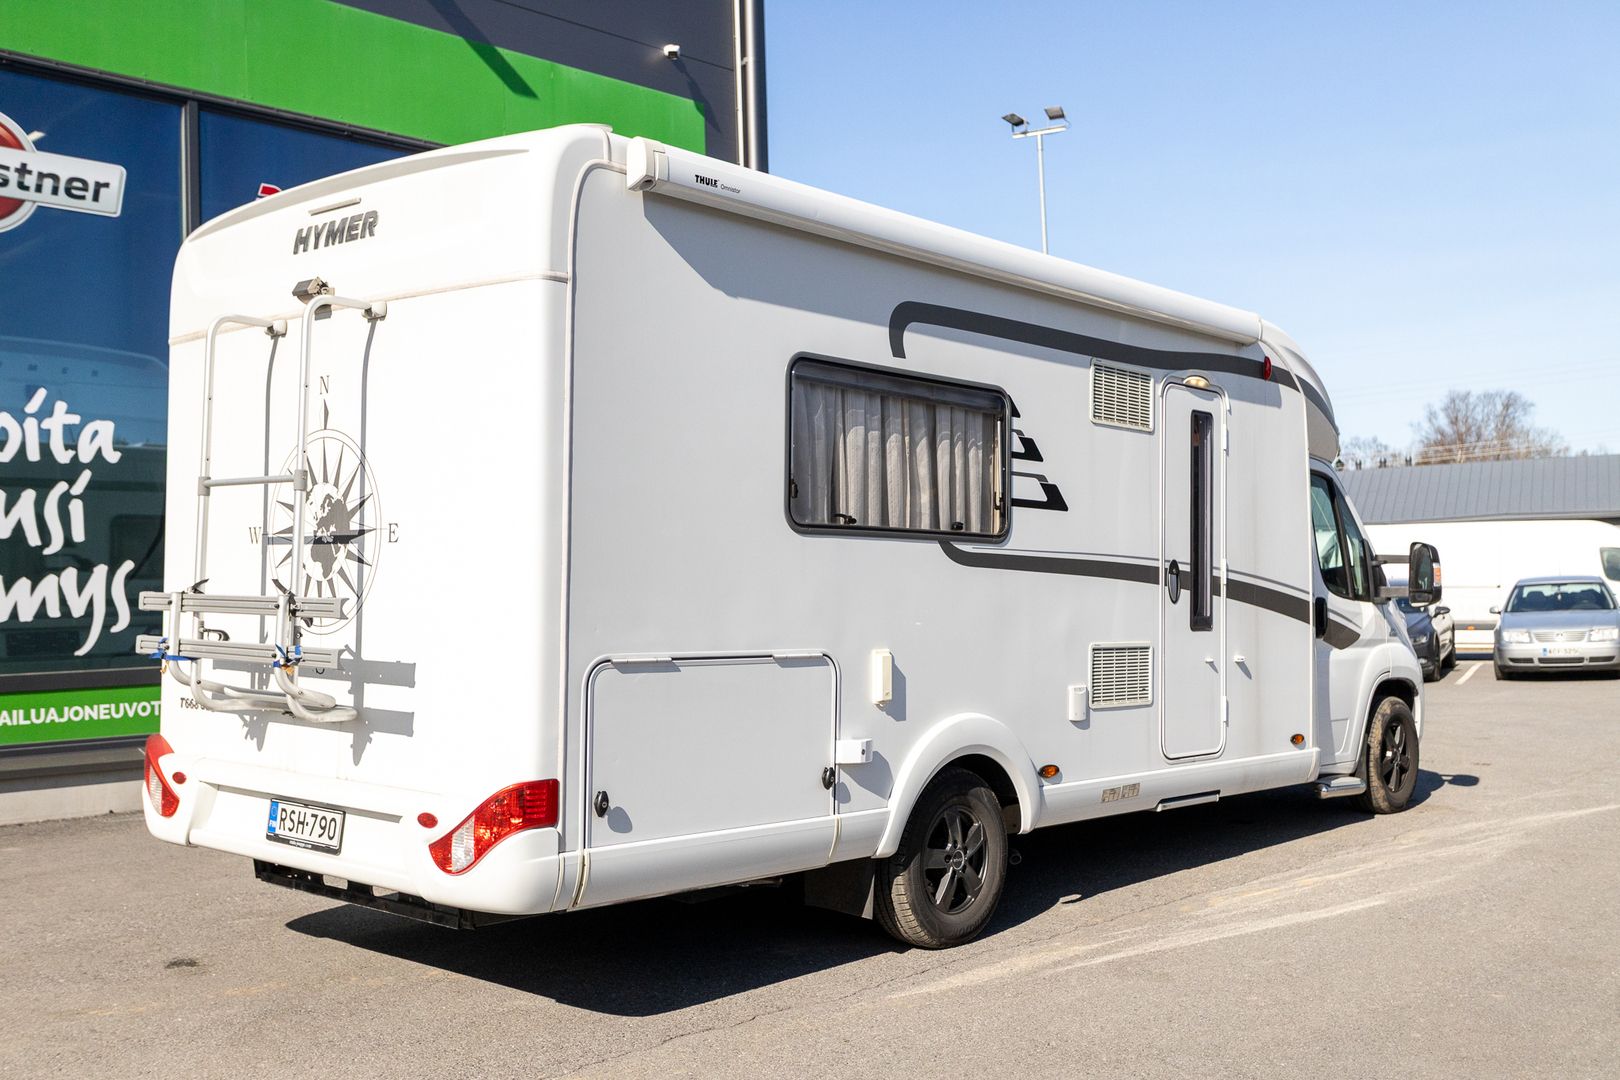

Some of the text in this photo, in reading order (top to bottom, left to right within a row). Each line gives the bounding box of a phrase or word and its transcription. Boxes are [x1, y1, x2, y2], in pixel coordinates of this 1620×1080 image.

[694, 174, 718, 187] THULE
[293, 209, 378, 255] HYMER
[319, 375, 330, 395] N
[248, 526, 262, 545] W
[387, 522, 399, 543] E
[0, 700, 161, 726] AILUAJONEUVOT
[279, 808, 336, 840] RSH-790
